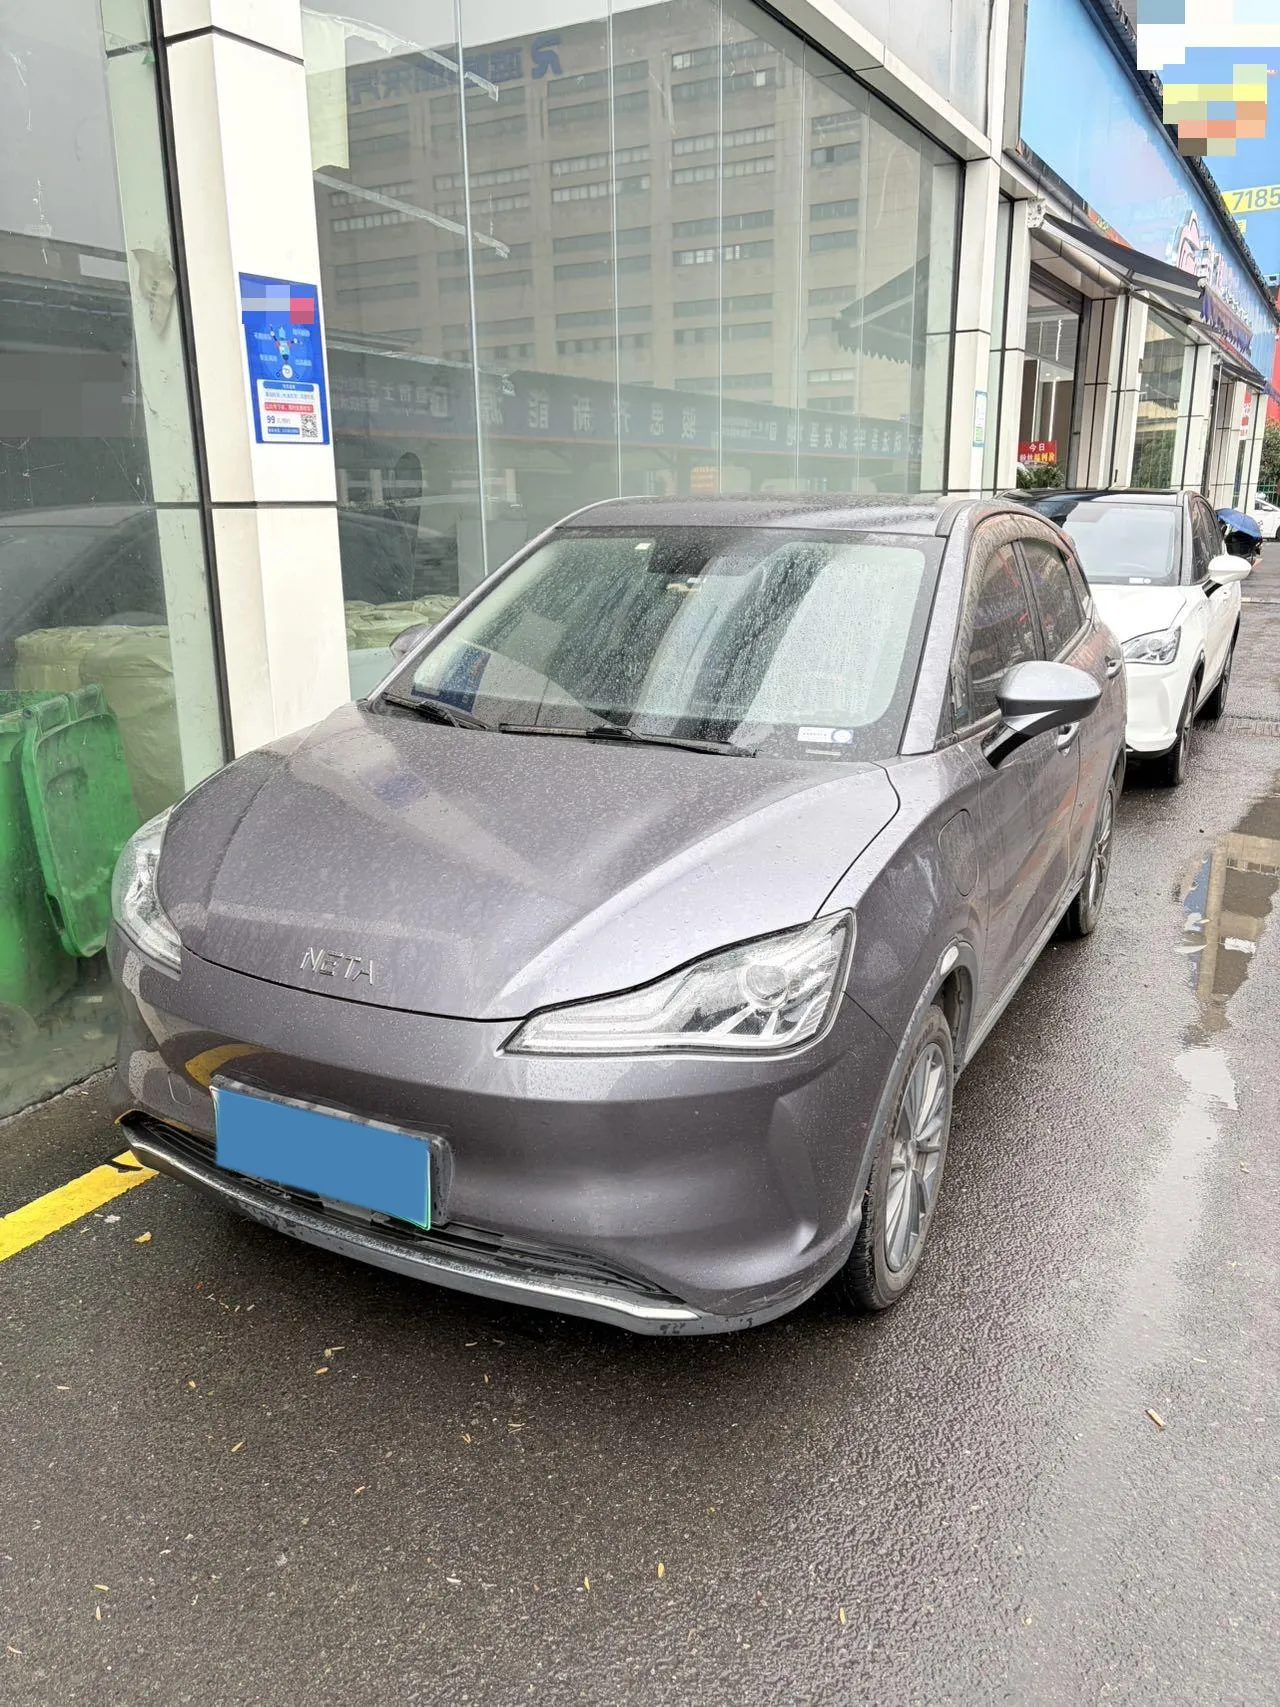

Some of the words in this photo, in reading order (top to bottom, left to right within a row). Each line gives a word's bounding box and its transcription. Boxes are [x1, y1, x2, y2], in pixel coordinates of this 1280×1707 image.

[1232, 187, 1280, 210] 7185
[266, 415, 276, 424] 99
[1029, 443, 1045, 452] 今日
[300, 947, 373, 985] NETA
